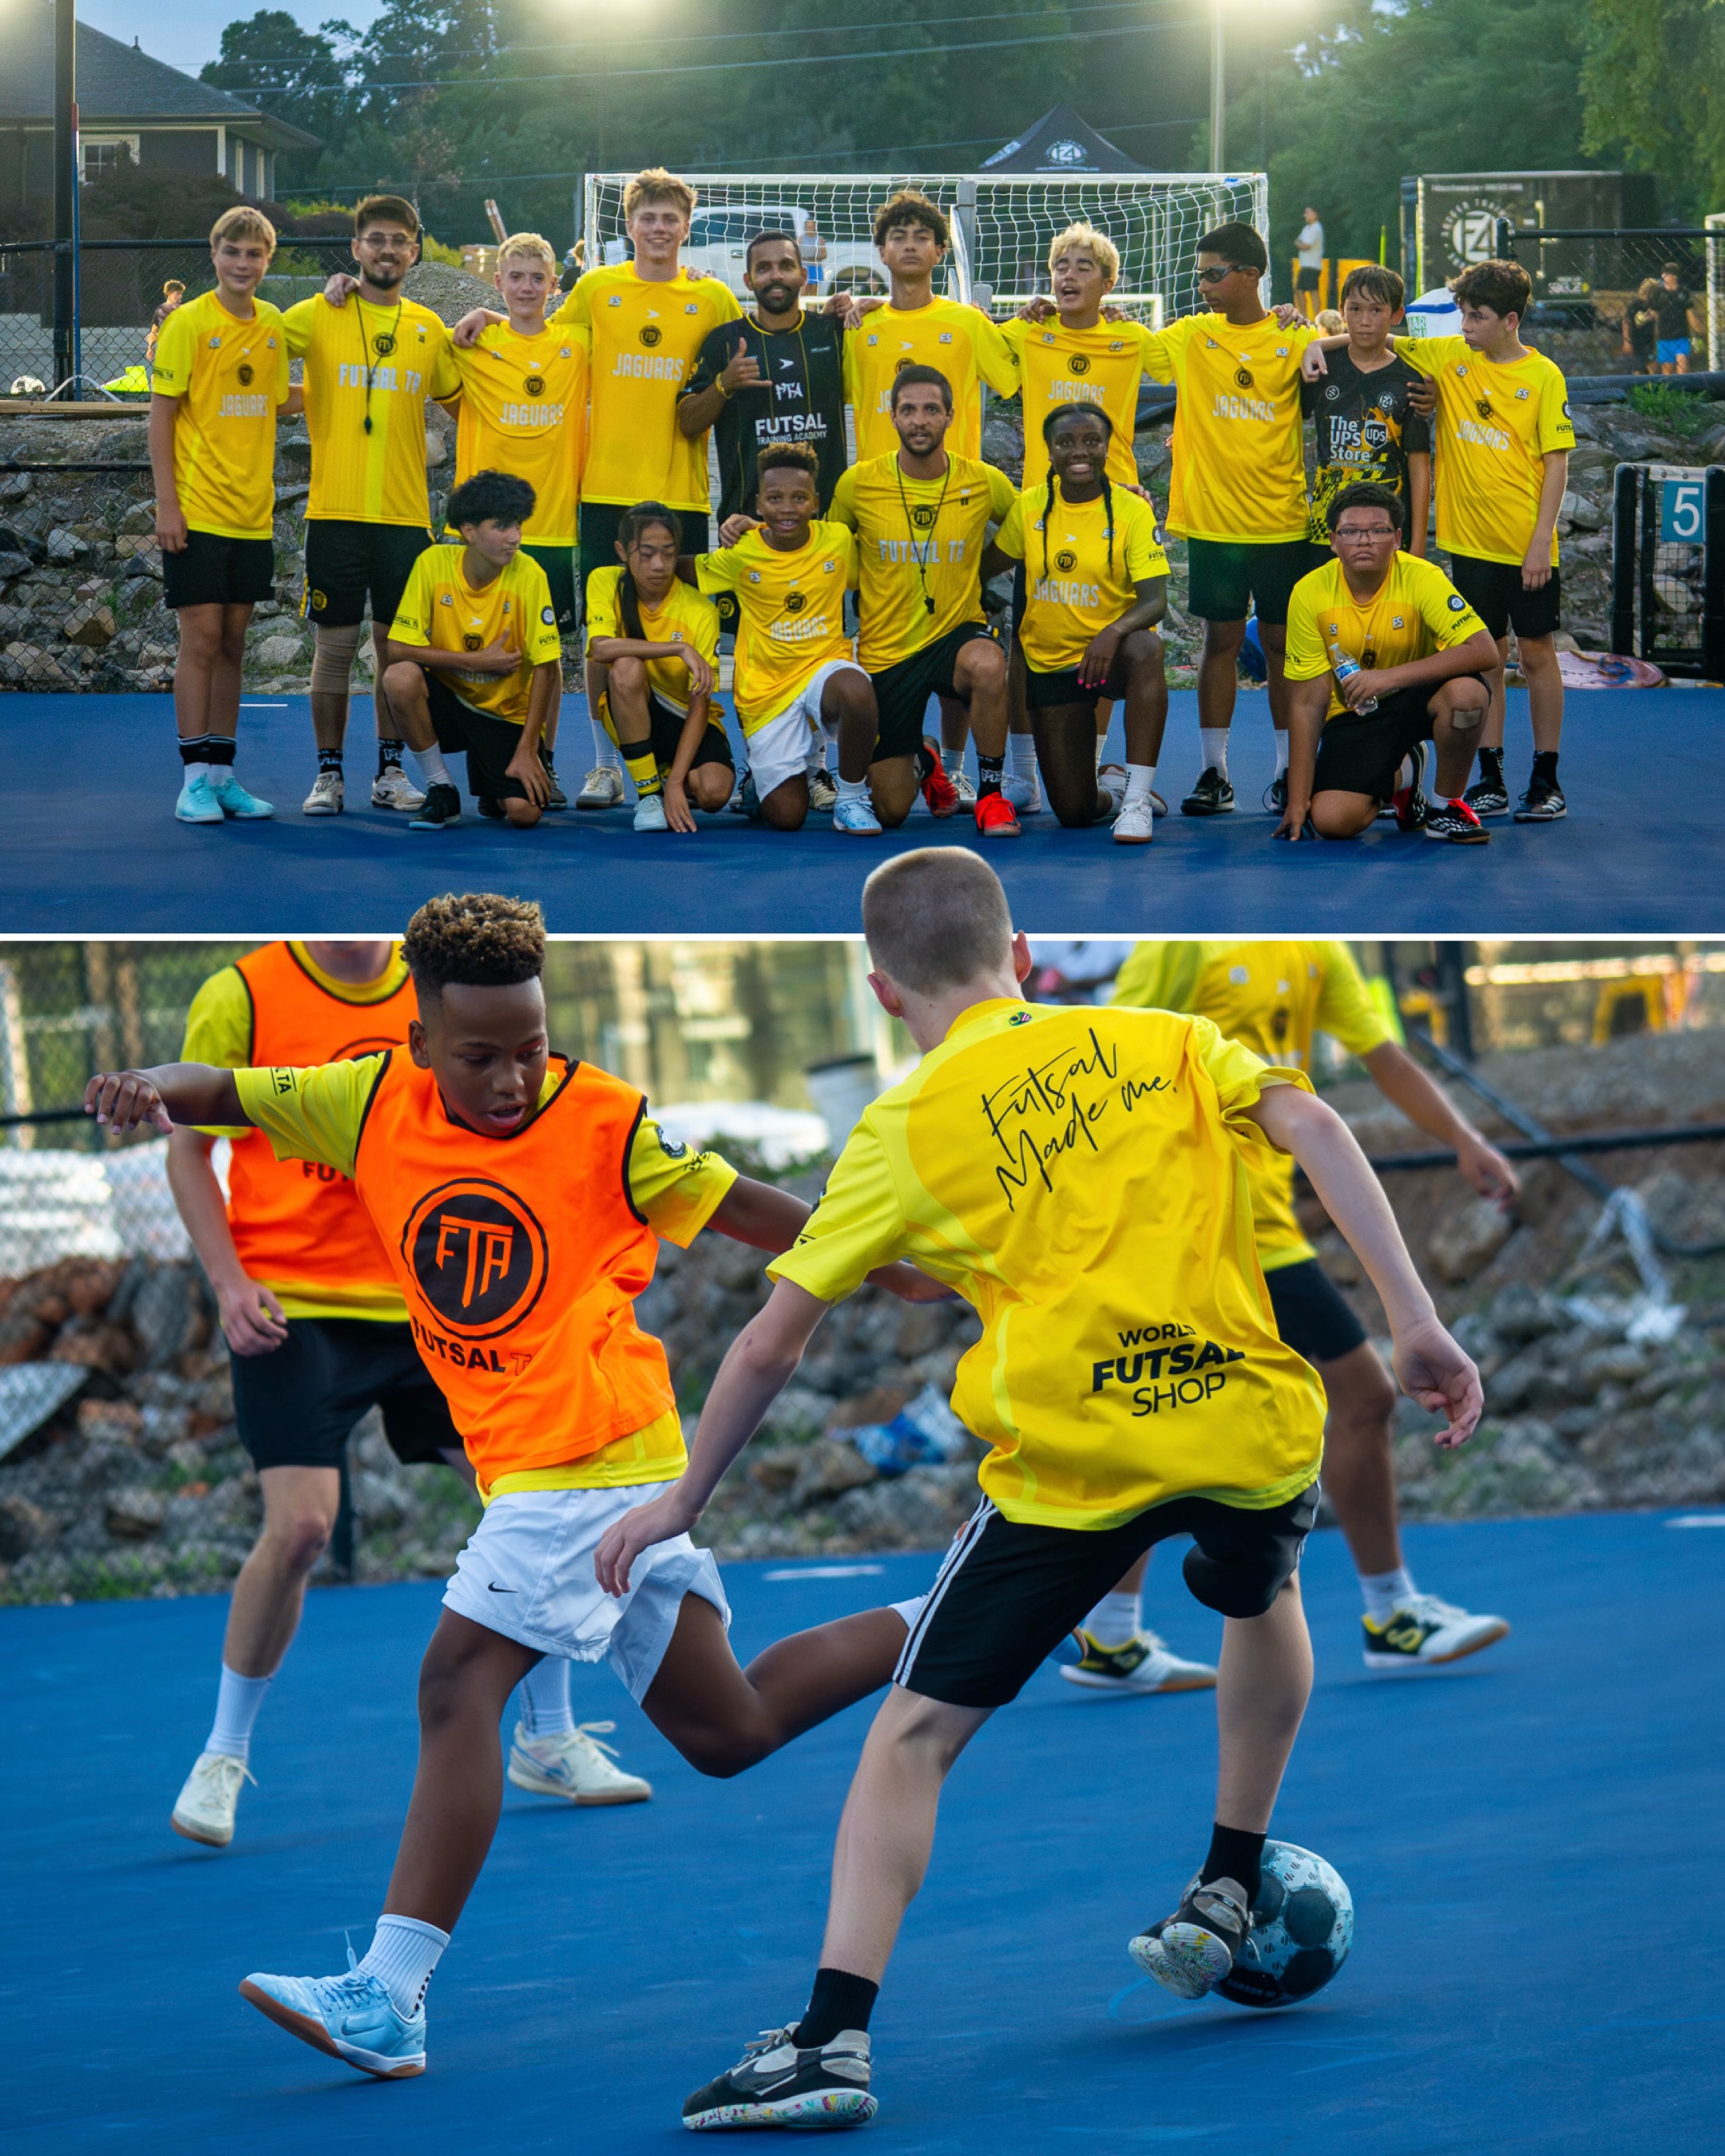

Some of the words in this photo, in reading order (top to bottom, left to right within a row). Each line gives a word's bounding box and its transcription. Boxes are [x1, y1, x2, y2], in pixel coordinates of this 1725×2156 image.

[339, 363, 398, 390] FUTSAL
[613, 352, 685, 382] JAGUARS
[1048, 379, 1105, 405] JAGUARS
[499, 402, 564, 426] JAGUARS
[1212, 394, 1275, 422] JAGUARS
[755, 413, 827, 437] FUTSAL
[1329, 415, 1358, 431] The
[1366, 428, 1386, 445] ups
[1456, 418, 1510, 450] JAGUARS
[757, 434, 791, 446] TRAINING
[794, 430, 827, 441] ACADEMY
[1330, 430, 1362, 446] UPS
[1330, 445, 1370, 462] Store
[1673, 487, 1699, 537] 5
[878, 539, 940, 563] FUTSAL
[1033, 578, 1100, 608] JAGUARS
[276, 1075, 291, 1094] TA
[981, 1028, 1117, 1164] Futsal
[996, 1092, 1108, 1212] Made
[435, 1214, 514, 1309] FTA
[412, 1314, 506, 1373] FUTSAL
[1132, 1372, 1226, 1417] SHOP
